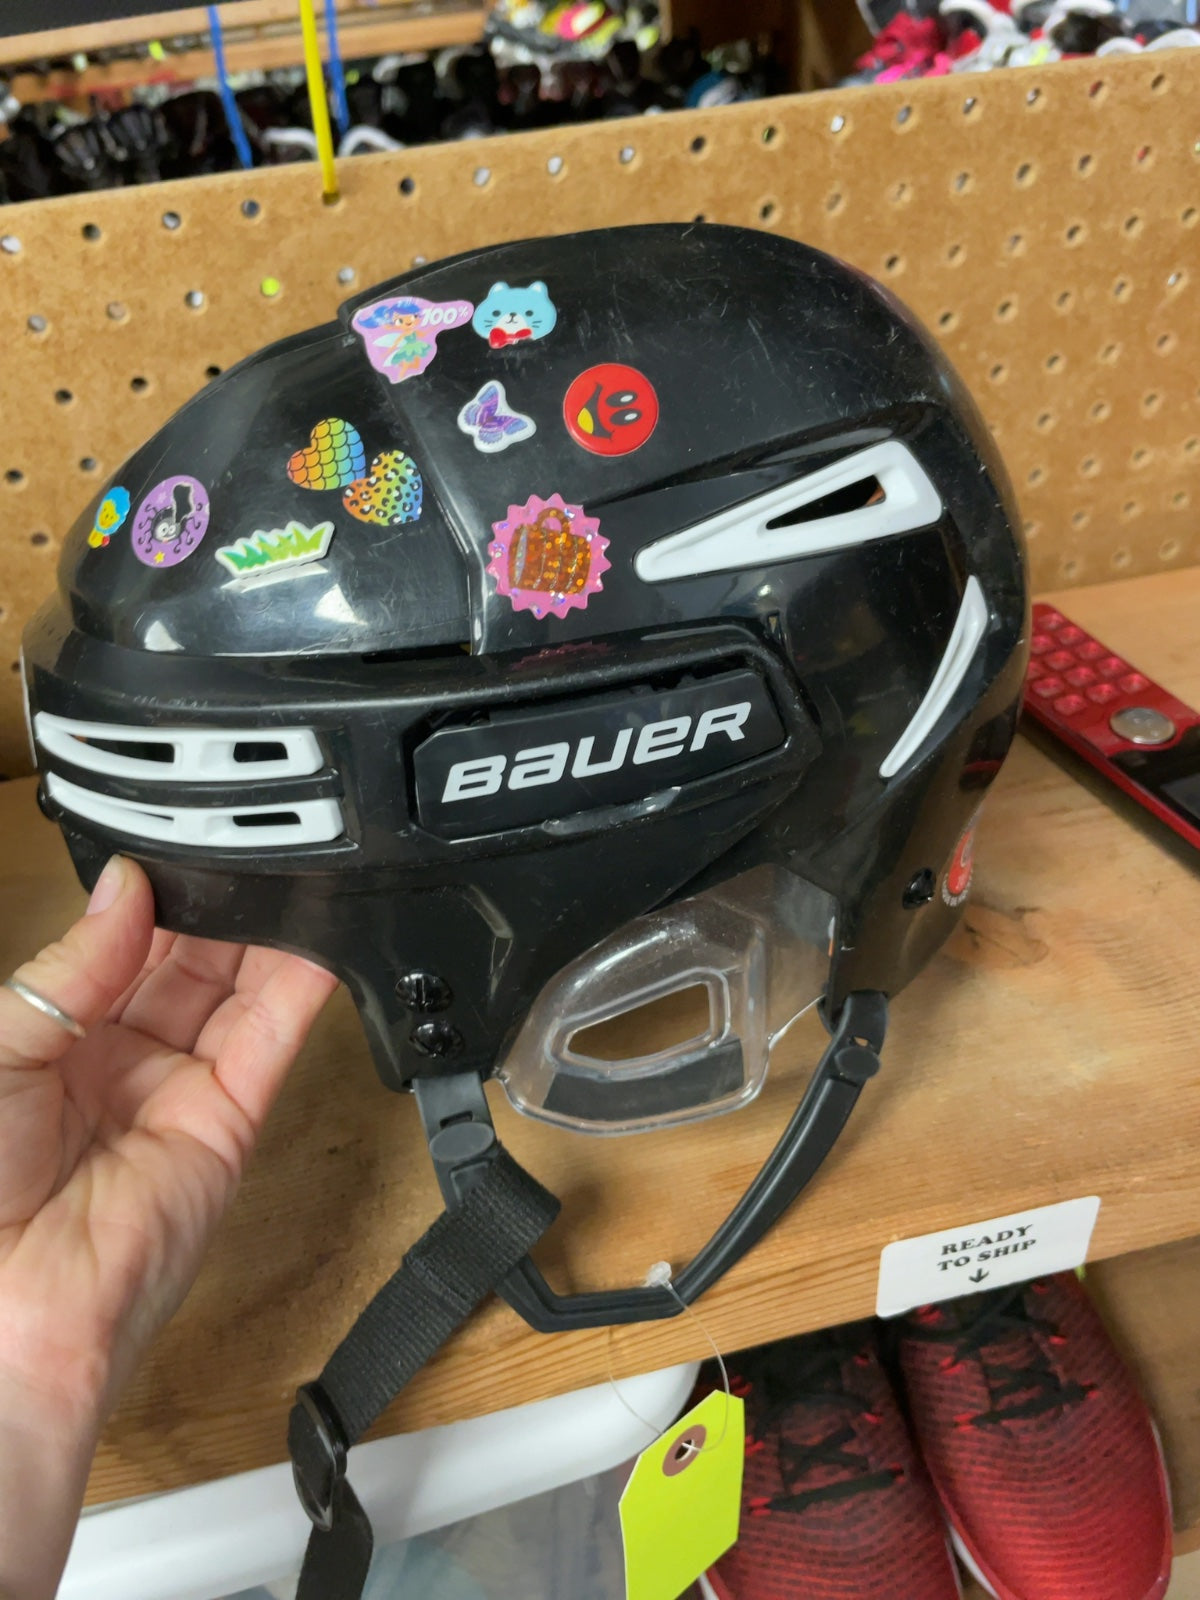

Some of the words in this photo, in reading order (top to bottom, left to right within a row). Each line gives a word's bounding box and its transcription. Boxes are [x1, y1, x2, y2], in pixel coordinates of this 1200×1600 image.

[421, 306, 469, 327] 100%
[937, 1256, 971, 1271] TO
[977, 1239, 1037, 1262] SHIP
[941, 1224, 1033, 1255] READY
